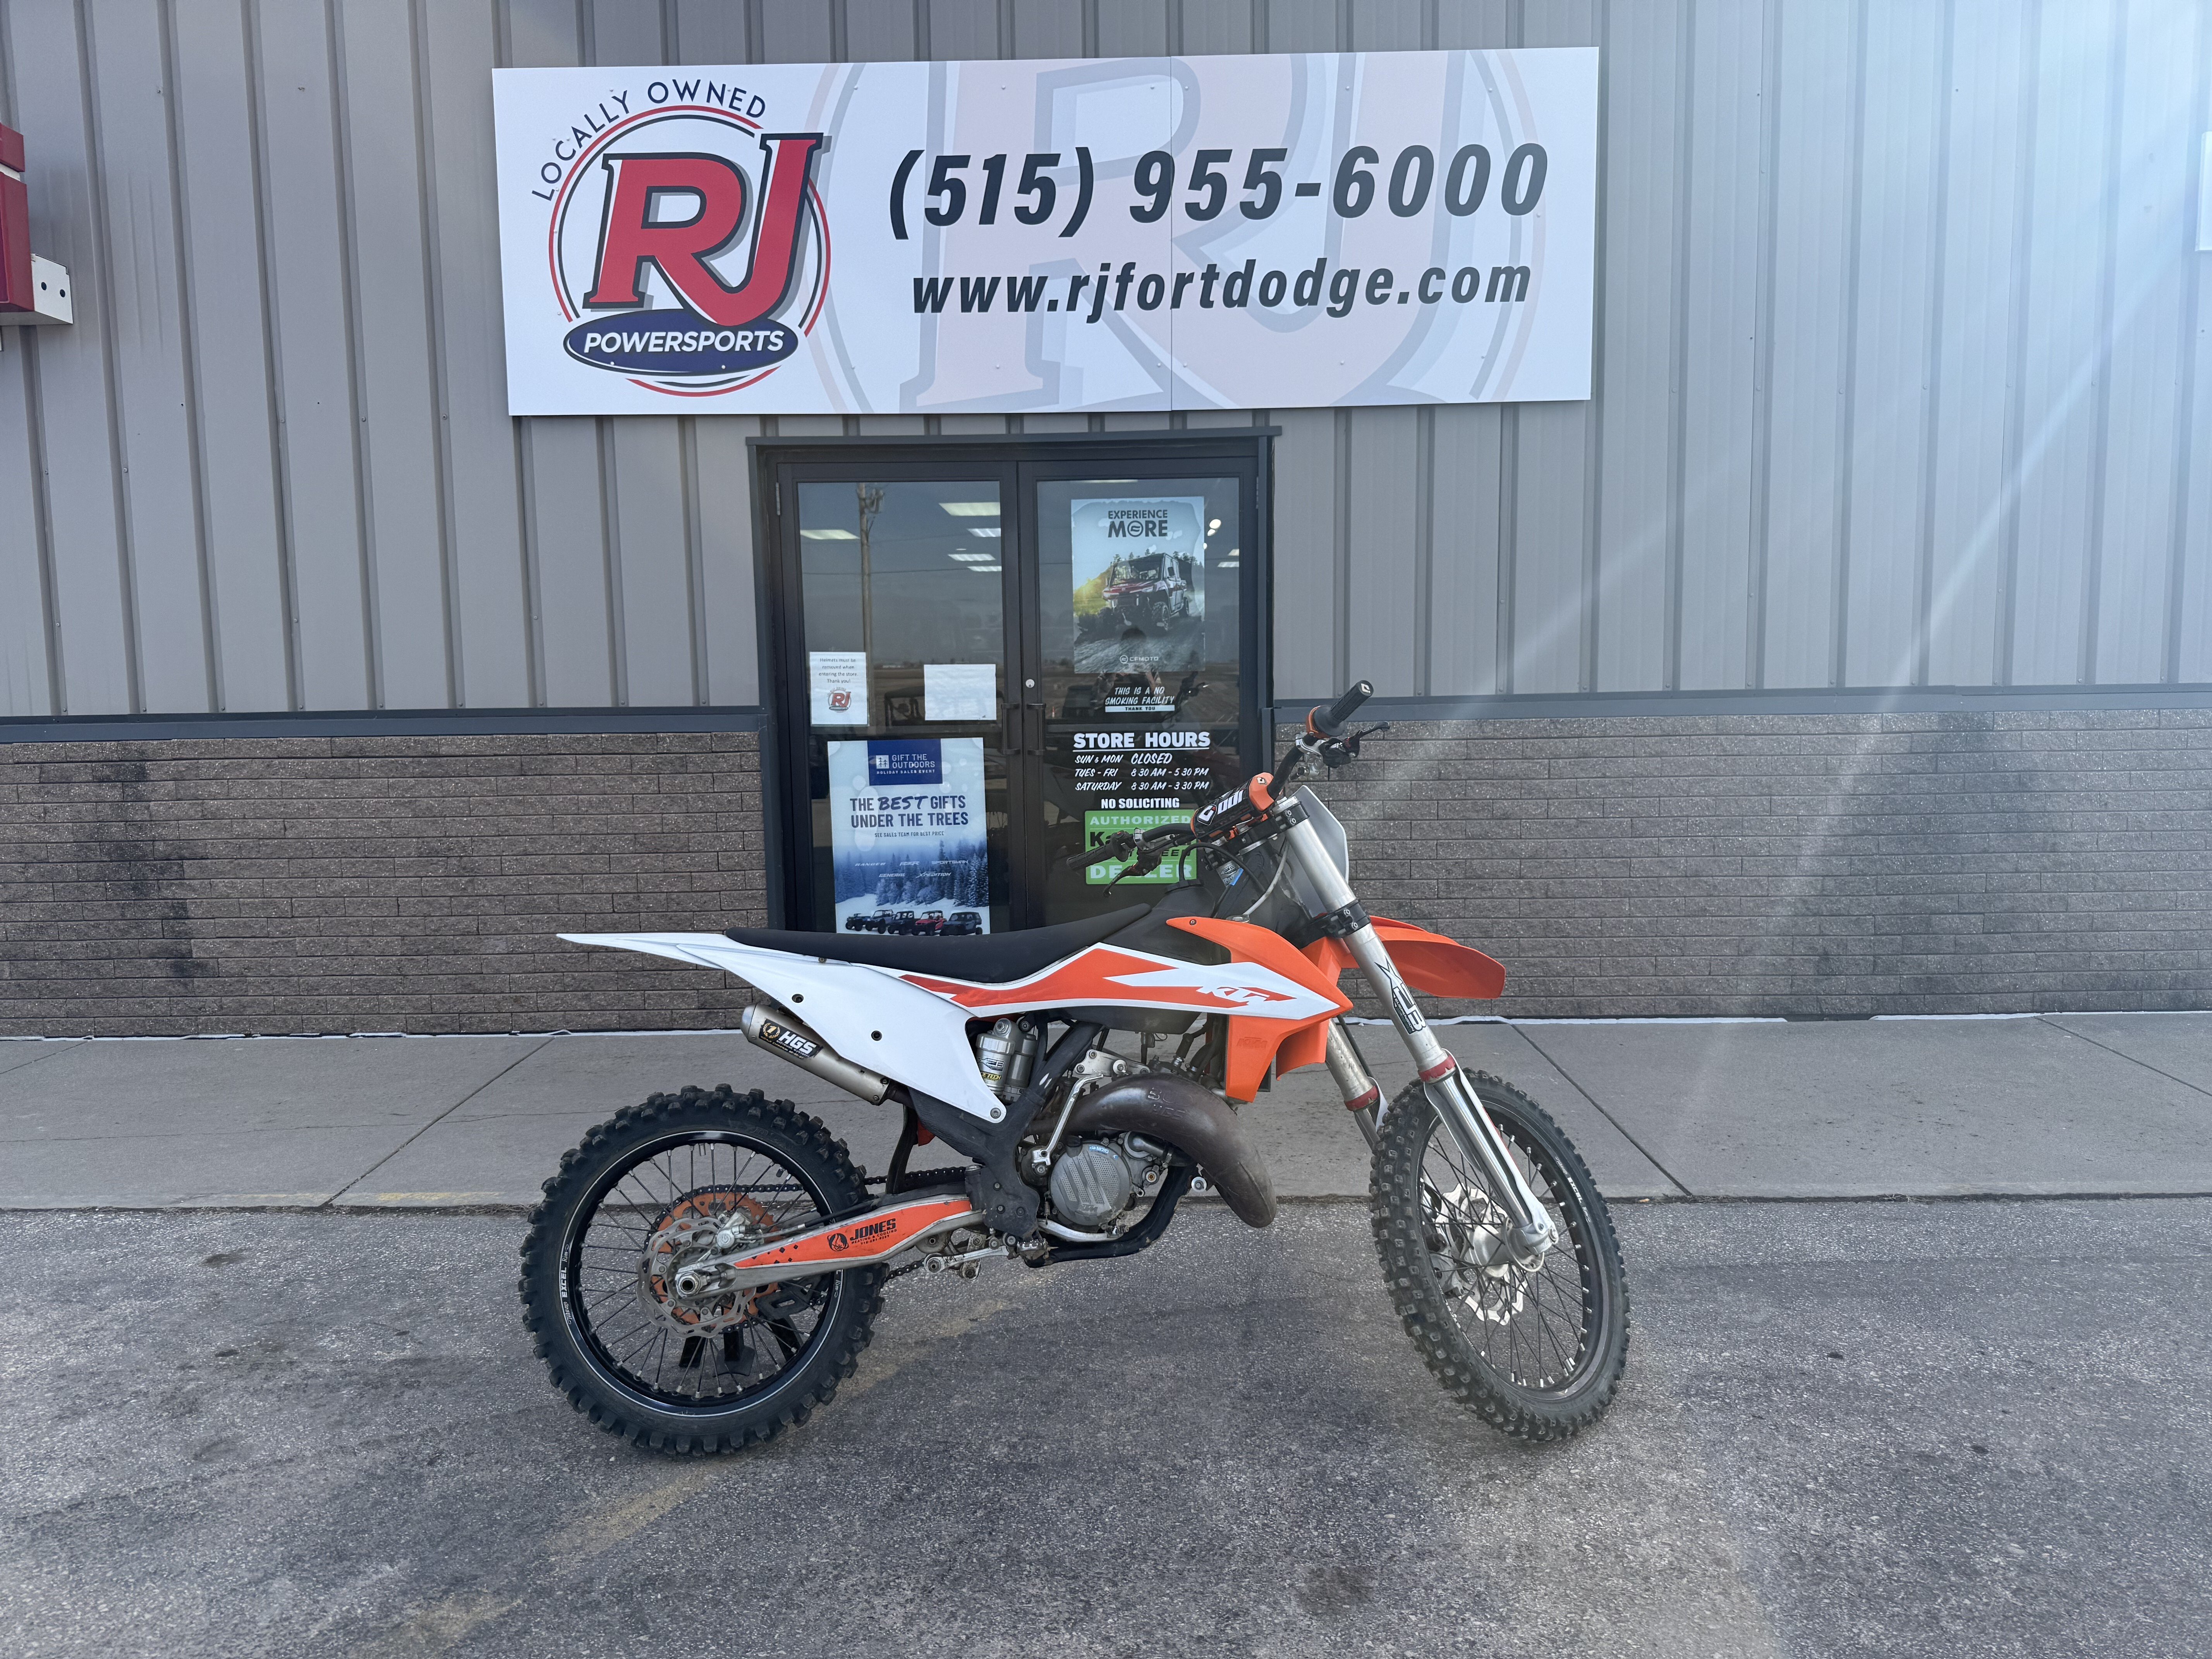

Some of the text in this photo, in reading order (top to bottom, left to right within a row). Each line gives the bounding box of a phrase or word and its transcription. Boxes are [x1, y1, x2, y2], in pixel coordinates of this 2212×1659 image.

[532, 79, 766, 201] LOCALLY OWNED
[890, 143, 1548, 240] (515) 955-6000
[582, 132, 829, 326] RJ
[913, 258, 1530, 324] www.rjfortdodge.com
[584, 330, 784, 353] POWERSPORTS
[1108, 510, 1168, 519] EXPERIENCE
[1154, 686, 1164, 694] NO
[831, 692, 851, 708] RJ
[1105, 696, 1175, 705] SMOKING FACILITY
[1073, 732, 1211, 748] STORE HOURS
[1075, 755, 1094, 763] SUN
[1101, 754, 1123, 763] MON
[1131, 753, 1173, 764] CLOSED
[1075, 768, 1096, 776] TUES
[1103, 768, 1118, 776] FRI
[1150, 768, 1167, 776] AM
[1075, 781, 1122, 790] SATURDAY
[1150, 781, 1167, 790] AM
[850, 795, 966, 811] THE BEST GIFTS
[1101, 798, 1180, 809] NO SOLICITING
[851, 812, 968, 828] UNDER THE TREES
[1090, 816, 1191, 825] AUTHORIZED
[778, 1031, 817, 1054] HGS
[1567, 1177, 1583, 1203] EXCEL
[850, 1218, 896, 1240] JONES
[877, 1229, 897, 1237] COOLING
